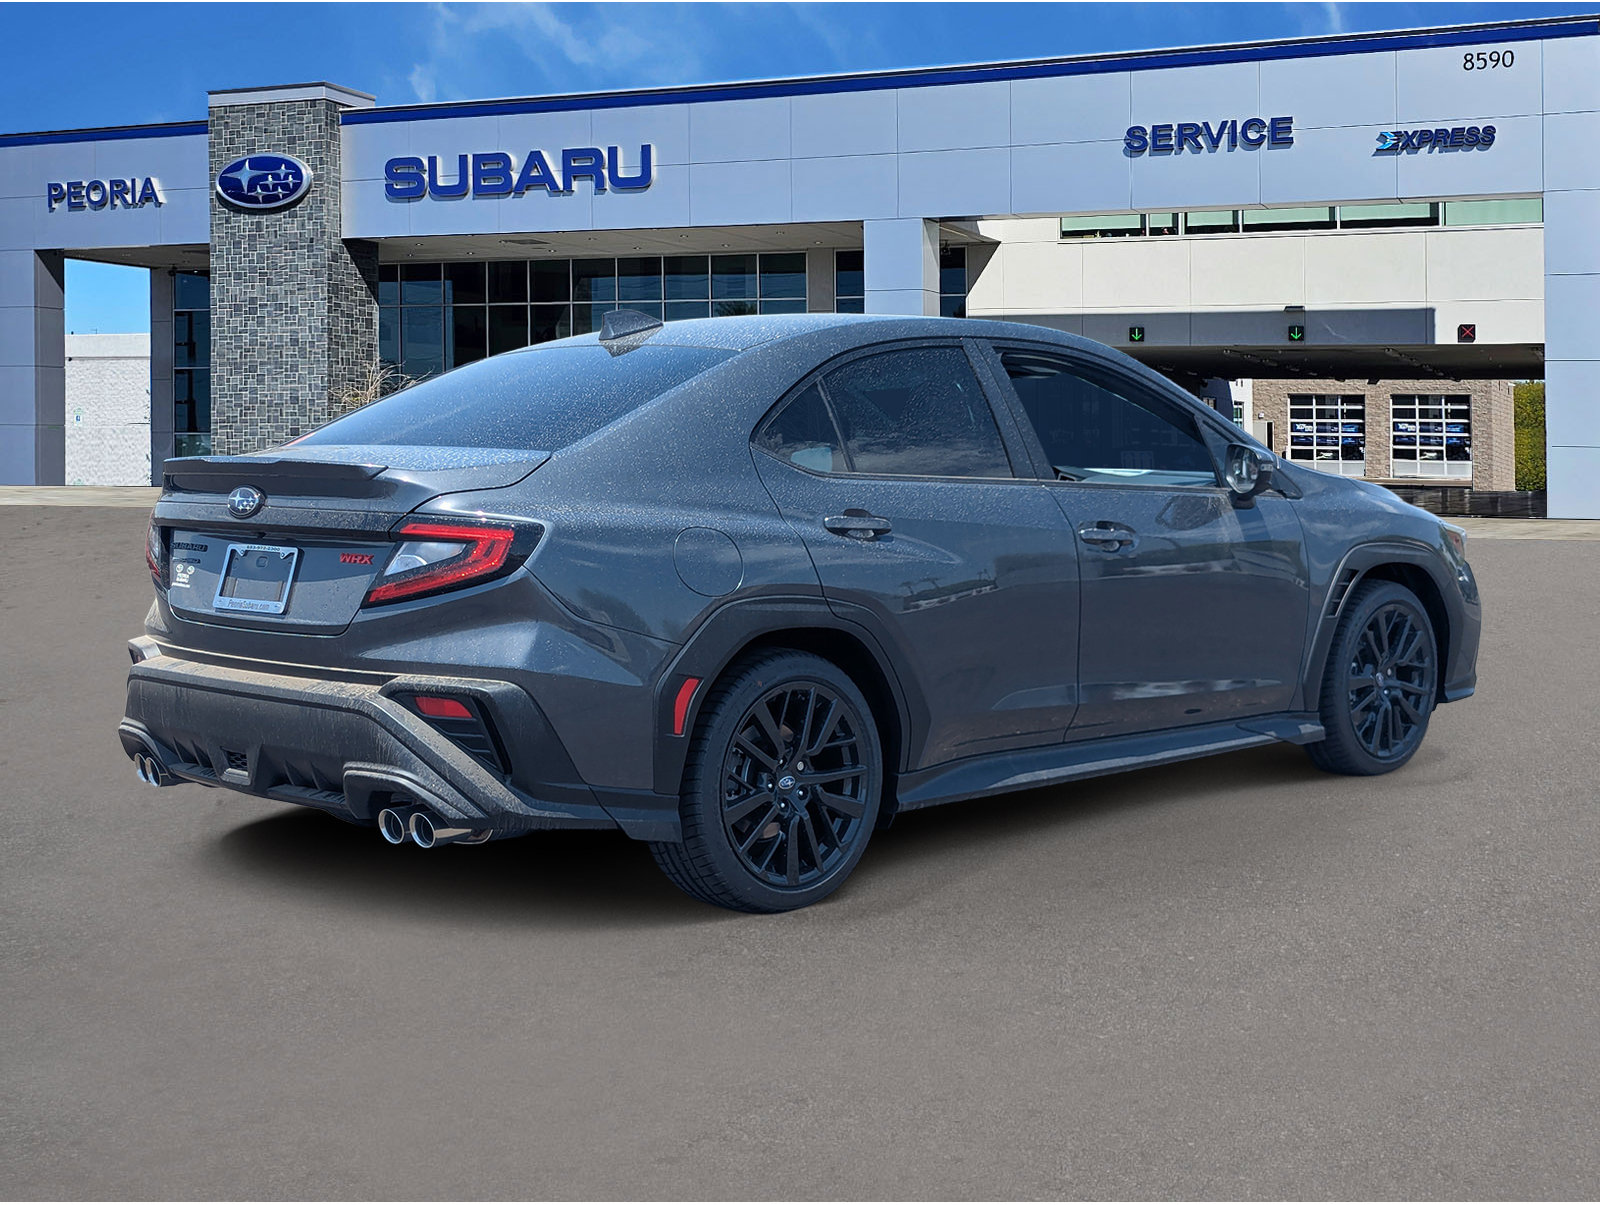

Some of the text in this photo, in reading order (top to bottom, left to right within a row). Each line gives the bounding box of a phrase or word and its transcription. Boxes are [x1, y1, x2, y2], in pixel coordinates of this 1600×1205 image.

[1463, 50, 1515, 71] 8590
[1124, 116, 1294, 153] SERVICE
[1375, 125, 1497, 151] EXPRESS
[384, 144, 653, 201] SUBARU
[48, 177, 164, 211] PEORIA
[340, 552, 374, 565] WRX
